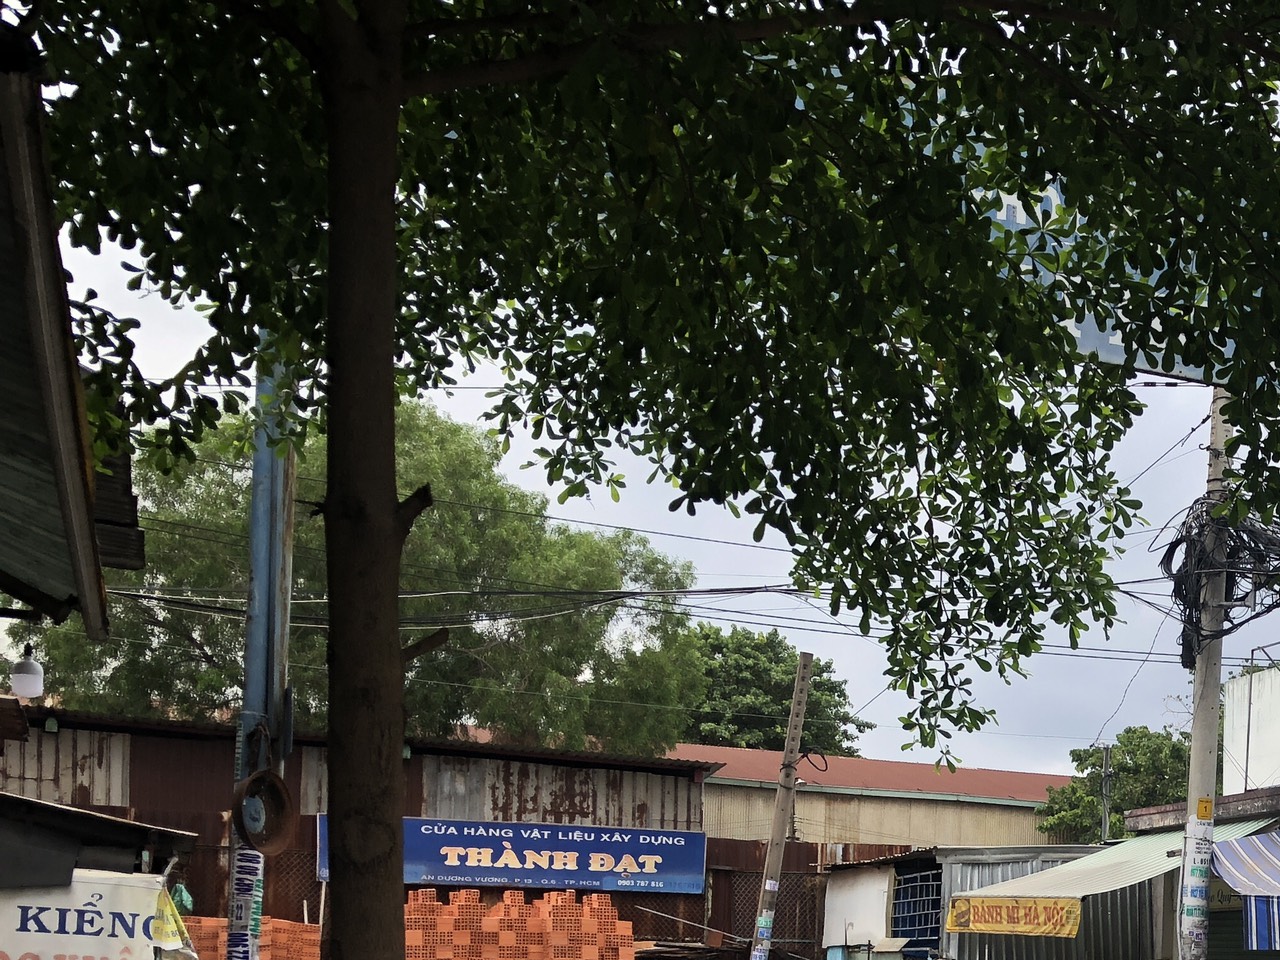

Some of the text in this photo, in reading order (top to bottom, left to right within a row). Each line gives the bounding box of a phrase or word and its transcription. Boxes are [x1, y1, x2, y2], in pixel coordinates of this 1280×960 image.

[420, 823, 685, 846] CỬA HÀNG VẬT LIỆU XÂY DỰNG
[440, 841, 662, 878] THÀNH ĐẠT
[971, 900, 1002, 924] BÁNH
[1005, 900, 1020, 924] MÌ
[1023, 900, 1040, 926] HÀ
[1043, 900, 1065, 931] NỘI
